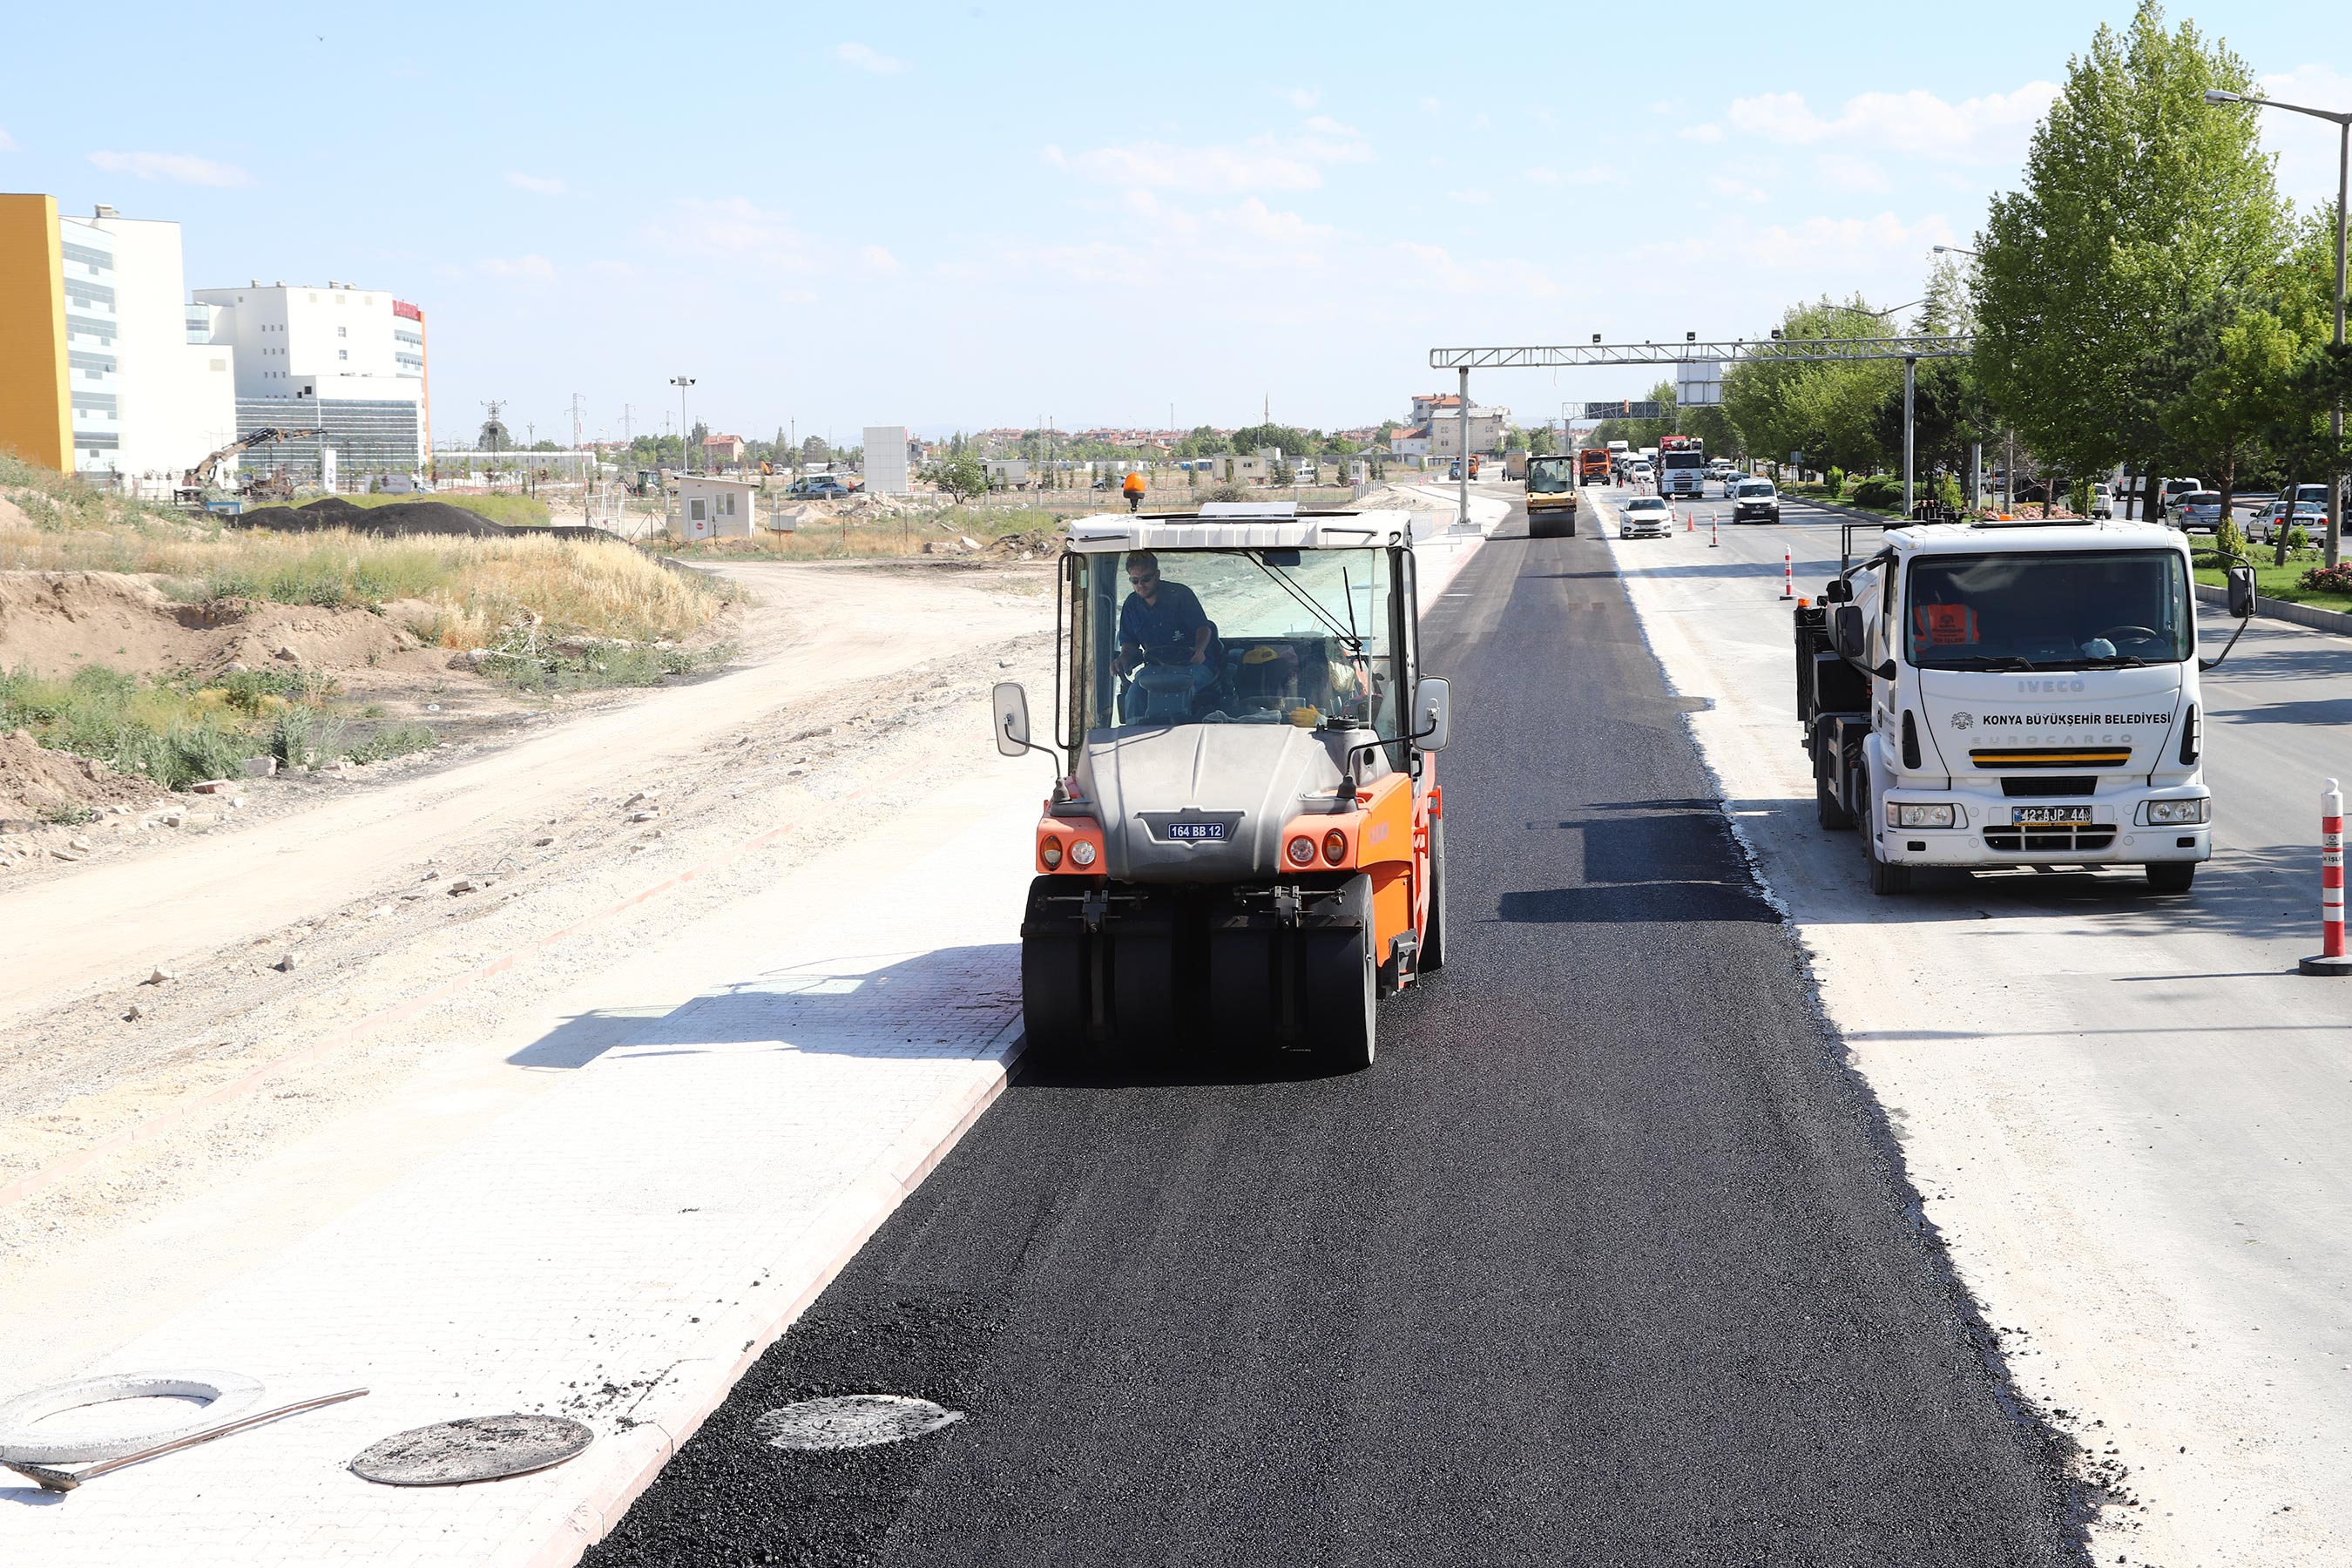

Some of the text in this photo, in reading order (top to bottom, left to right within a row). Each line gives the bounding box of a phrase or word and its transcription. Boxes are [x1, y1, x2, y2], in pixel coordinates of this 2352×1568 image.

[2018, 679, 2085, 693] IVECO
[1983, 710, 2172, 727] KONYA BÜYÜKŞEHİR BELEDİYESİ
[1971, 733, 2133, 746] EUROCARGO
[2021, 808, 2085, 821] 42 AJP 44
[1172, 825, 1221, 837] 164 BB 12
